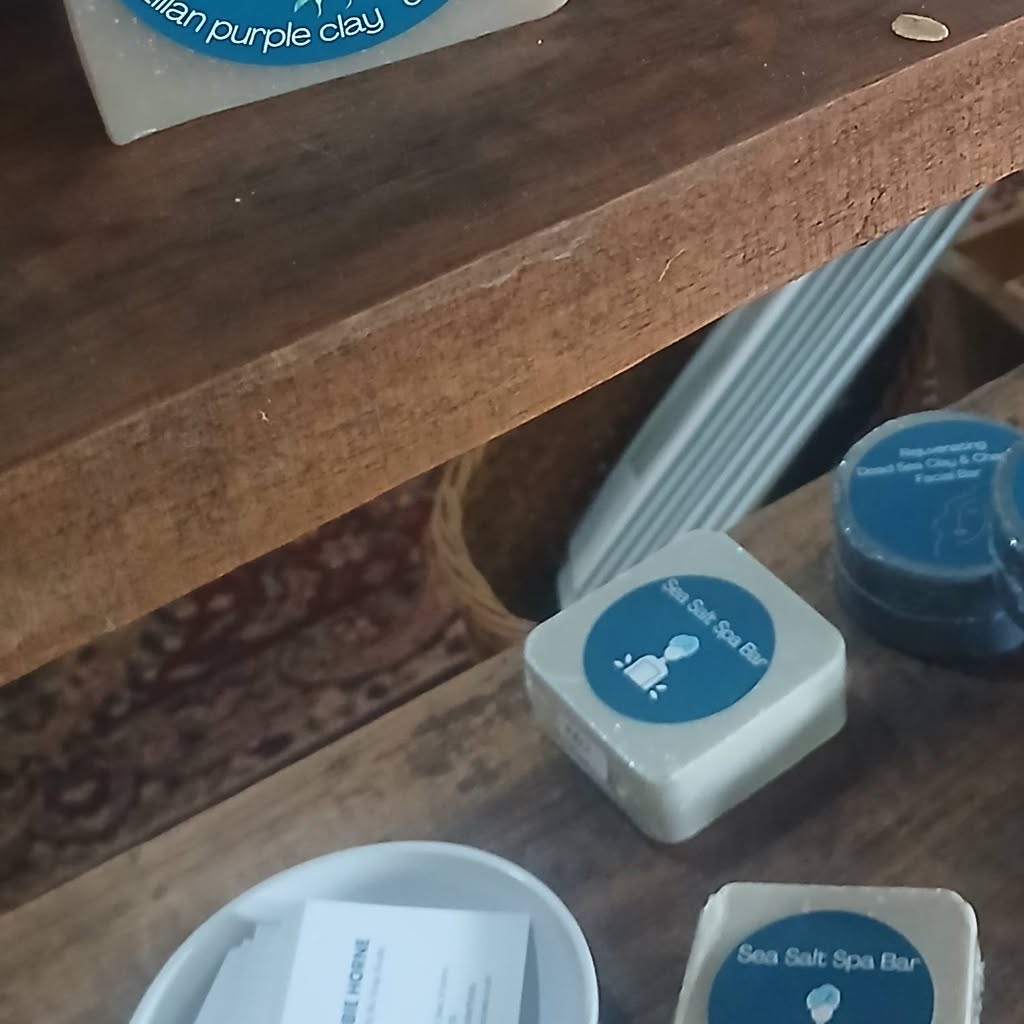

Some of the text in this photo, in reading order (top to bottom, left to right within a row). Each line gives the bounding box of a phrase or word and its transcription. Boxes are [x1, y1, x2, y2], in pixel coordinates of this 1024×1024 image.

[205, 13, 312, 54] purple
[318, 7, 385, 48] clay
[661, 577, 769, 667] Sea Salt Spa Bar
[737, 943, 922, 973] Sea Salt Spa Bar
